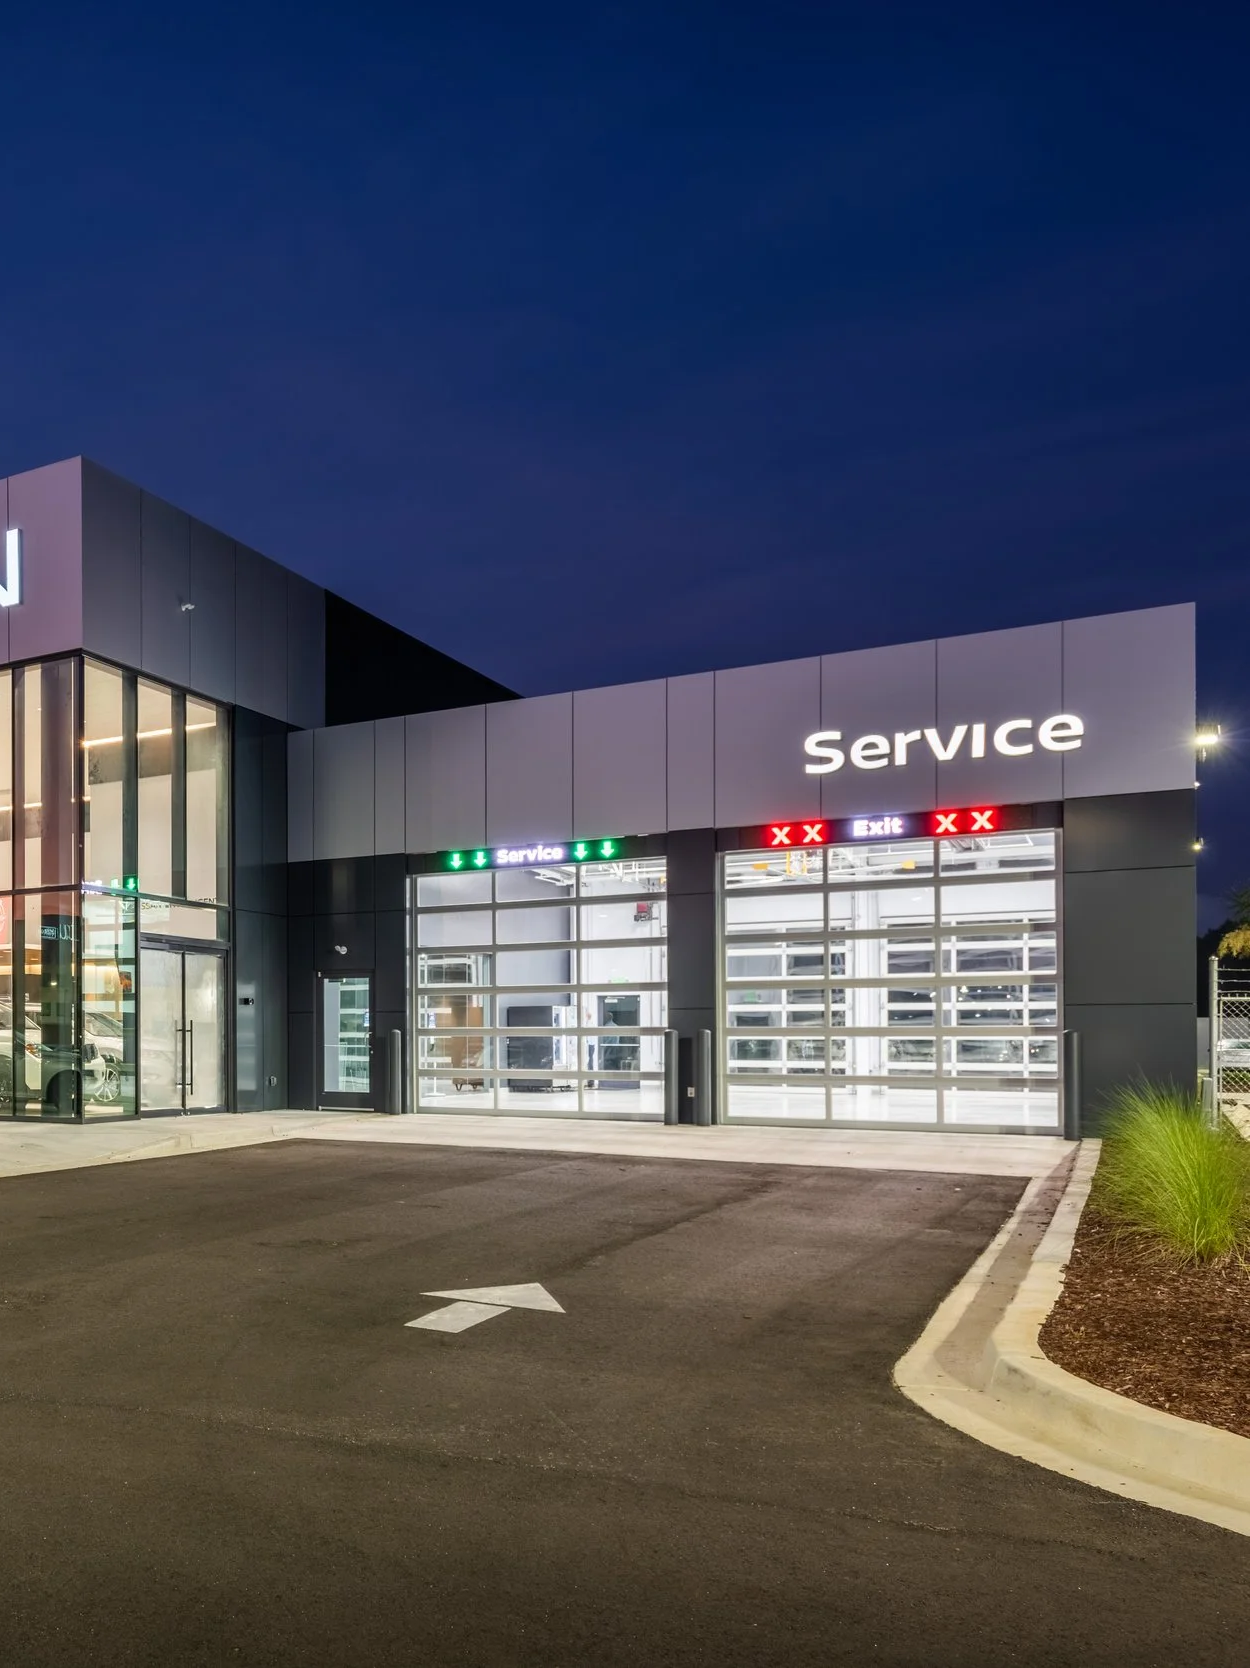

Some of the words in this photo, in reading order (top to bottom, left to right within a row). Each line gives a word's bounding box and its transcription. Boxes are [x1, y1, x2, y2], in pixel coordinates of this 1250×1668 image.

[803, 713, 1084, 774] Service
[853, 817, 903, 837] Exit
[496, 844, 563, 863] Service
